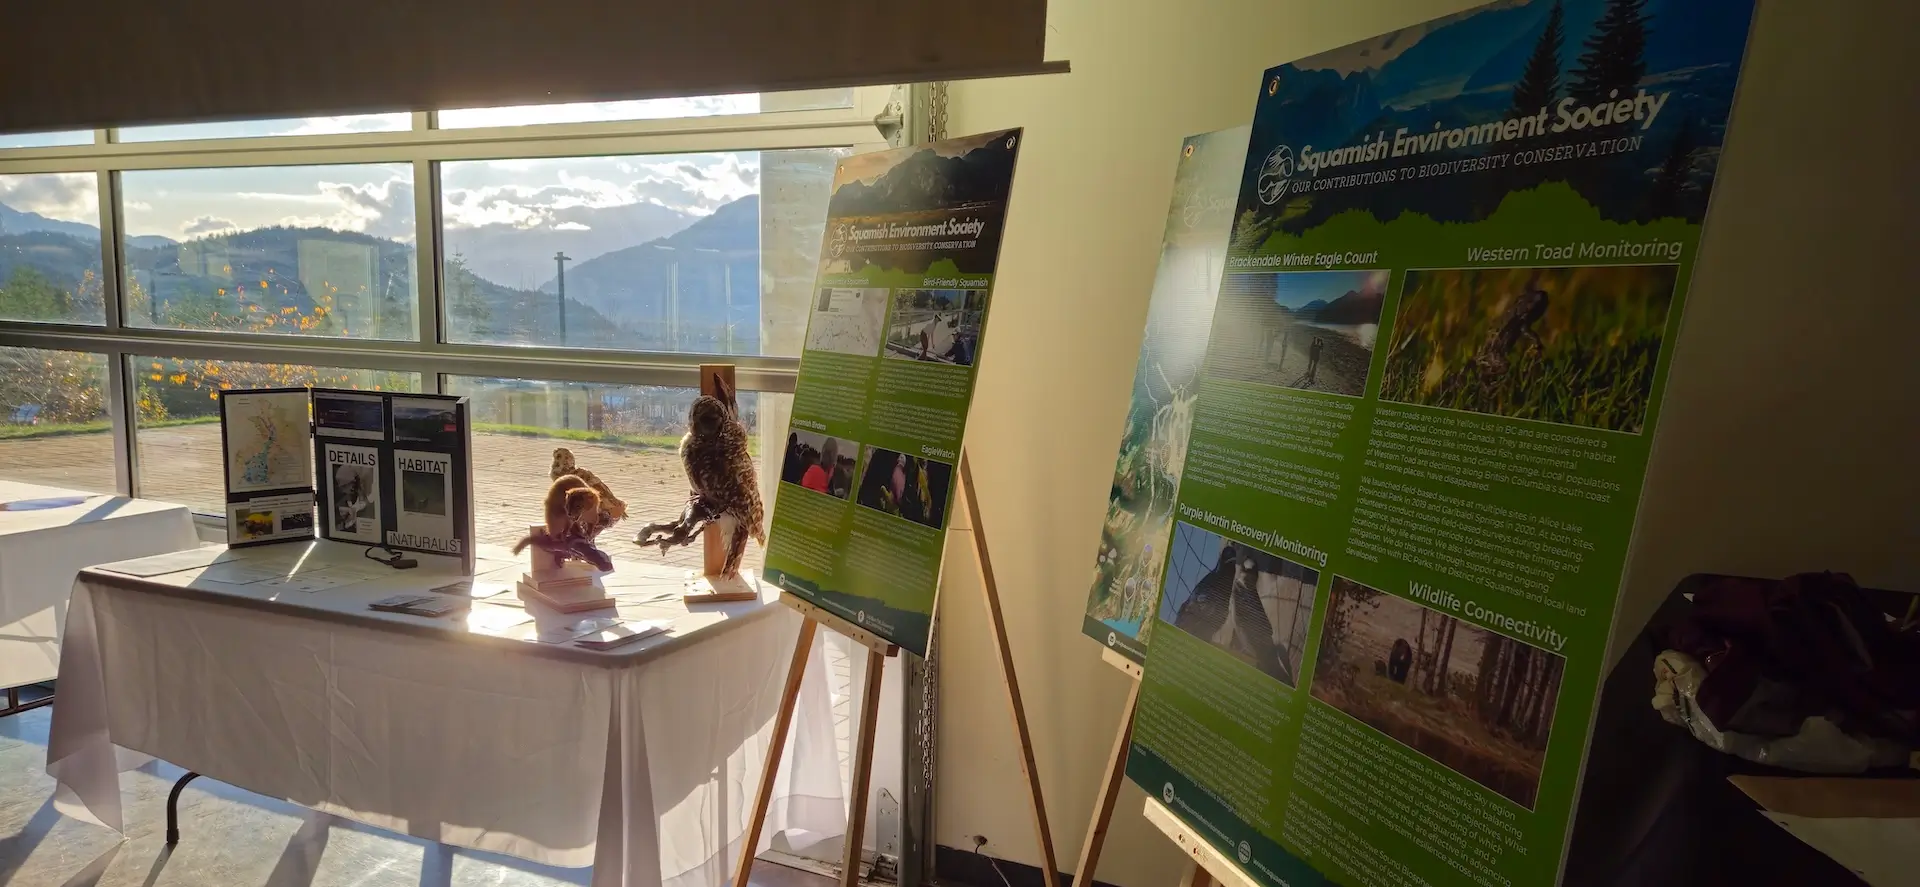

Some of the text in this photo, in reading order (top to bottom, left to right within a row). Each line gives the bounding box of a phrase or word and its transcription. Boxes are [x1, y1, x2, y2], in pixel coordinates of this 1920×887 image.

[1297, 89, 1670, 177] Squamish Environment Society
[1292, 135, 1644, 194] OUR CONTRIBUTIONS TO BIODIVERSITY CONSERVATION
[848, 217, 985, 244] Squamish Environment Society
[899, 241, 934, 251] BIODIVERSITY
[934, 240, 977, 250] CONSERVATION
[1229, 250, 1378, 268] Brackendale Winter Eagle Count
[1467, 238, 1683, 264] Western Toad Monitoring
[923, 278, 988, 289] Bird-Friendly Squamish
[1375, 407, 1401, 416] Western
[1442, 416, 1454, 425] the
[1505, 425, 1516, 434] BC
[1517, 428, 1533, 437] and
[1535, 431, 1549, 439] are
[1550, 433, 1599, 446] considered
[329, 450, 376, 466] DETAILS
[921, 444, 956, 459] EagleWatch
[1428, 425, 1457, 436] Concern
[1518, 441, 1531, 449] are
[1532, 443, 1569, 455] sensitive
[1584, 450, 1616, 463] habitat
[398, 457, 448, 474] HABITAT
[1384, 463, 1402, 472] some
[1462, 456, 1477, 464] and
[1542, 470, 1564, 480] Local
[1566, 474, 1620, 491] populations
[1515, 453, 1577, 469] environmental
[1401, 454, 1416, 464] Toad
[1462, 467, 1483, 479] along
[1558, 486, 1583, 497] south
[1585, 491, 1610, 503] coast
[1438, 494, 1464, 506] surveys
[1475, 503, 1507, 516] multiple
[1508, 510, 1526, 520] sites
[1538, 516, 1559, 528] Alice
[1561, 522, 1582, 533] Lake
[1474, 513, 1504, 528] Springs
[1550, 532, 1570, 542] both
[390, 532, 461, 552] iNATURALIST
[1180, 503, 1328, 567] Purple Martin Recovery/Monitoring
[1482, 529, 1511, 542] surveys
[1512, 536, 1540, 551] during
[1447, 544, 1462, 553] also
[1492, 556, 1514, 568] areas
[1516, 563, 1554, 582] requiring
[1473, 539, 1514, 556] determine
[1516, 550, 1530, 560] the
[1532, 554, 1560, 570] timing
[1561, 562, 1580, 573] and
[1402, 552, 1412, 562] BC
[1484, 578, 1524, 596] Squamish
[1525, 592, 1542, 602] and
[1544, 595, 1564, 609] local
[1566, 603, 1586, 616] land
[1465, 561, 1495, 576] support
[1496, 570, 1512, 580] and
[1514, 575, 1549, 593] ongoing
[1409, 580, 1568, 651] Wildlife Connectivity
[1408, 782, 1423, 795] land
